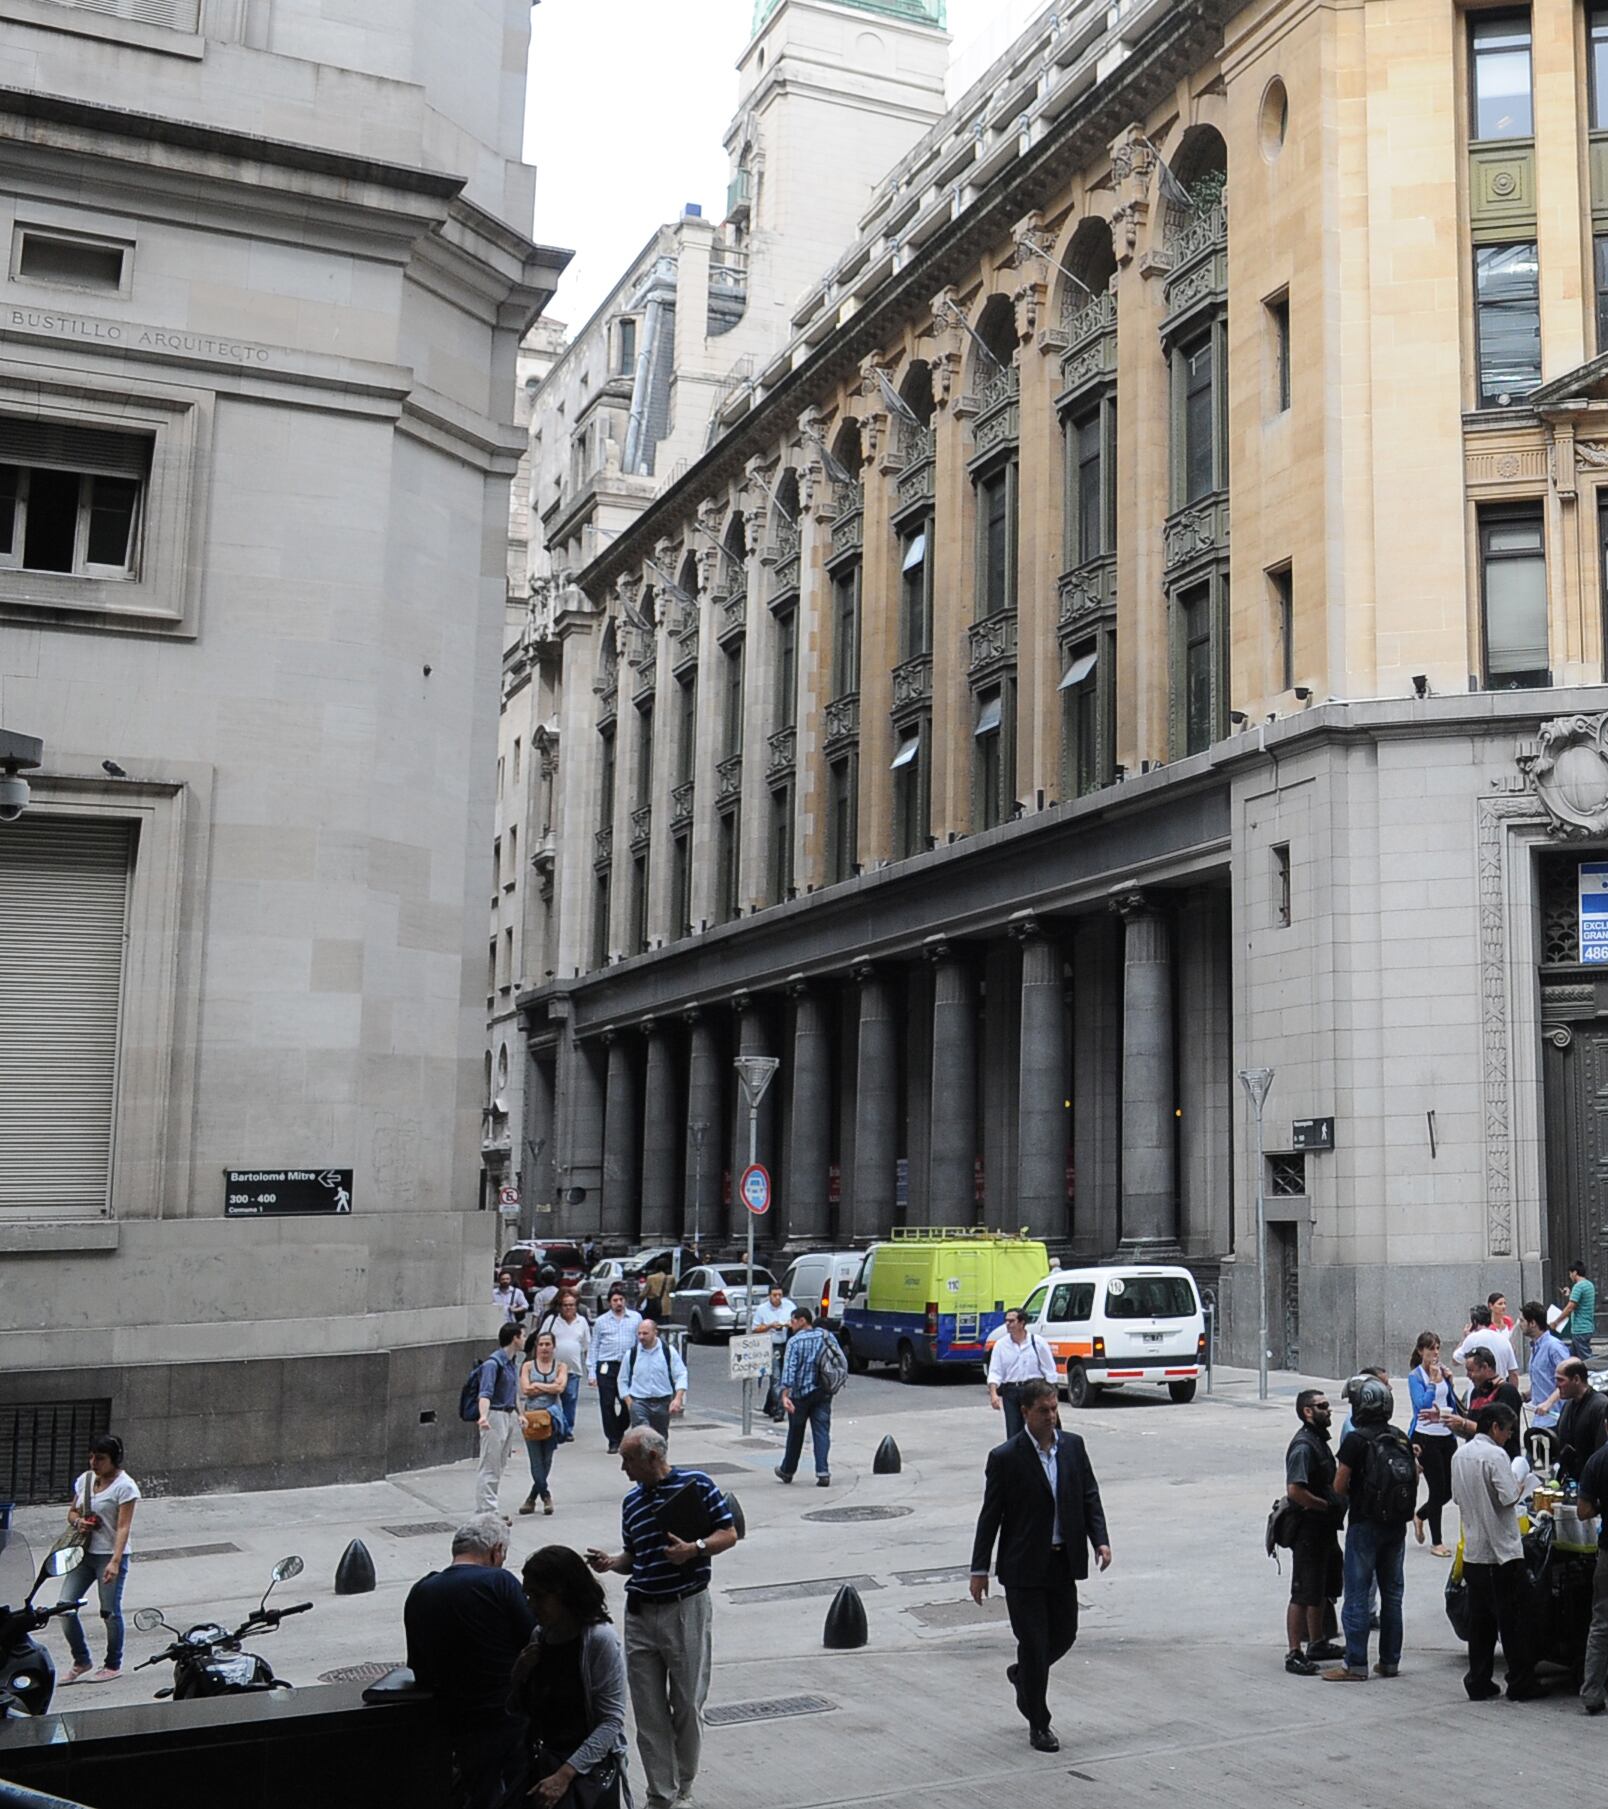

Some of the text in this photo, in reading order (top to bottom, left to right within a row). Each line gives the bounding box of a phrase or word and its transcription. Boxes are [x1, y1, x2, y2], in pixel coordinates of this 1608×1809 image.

[11, 311, 270, 362] BUSTILLO ARQUITECTO
[1584, 931, 1608, 940] GRAN
[231, 1171, 316, 1181] Bartolomé Mitre
[229, 1194, 248, 1203] 300
[257, 1193, 276, 1203] 400
